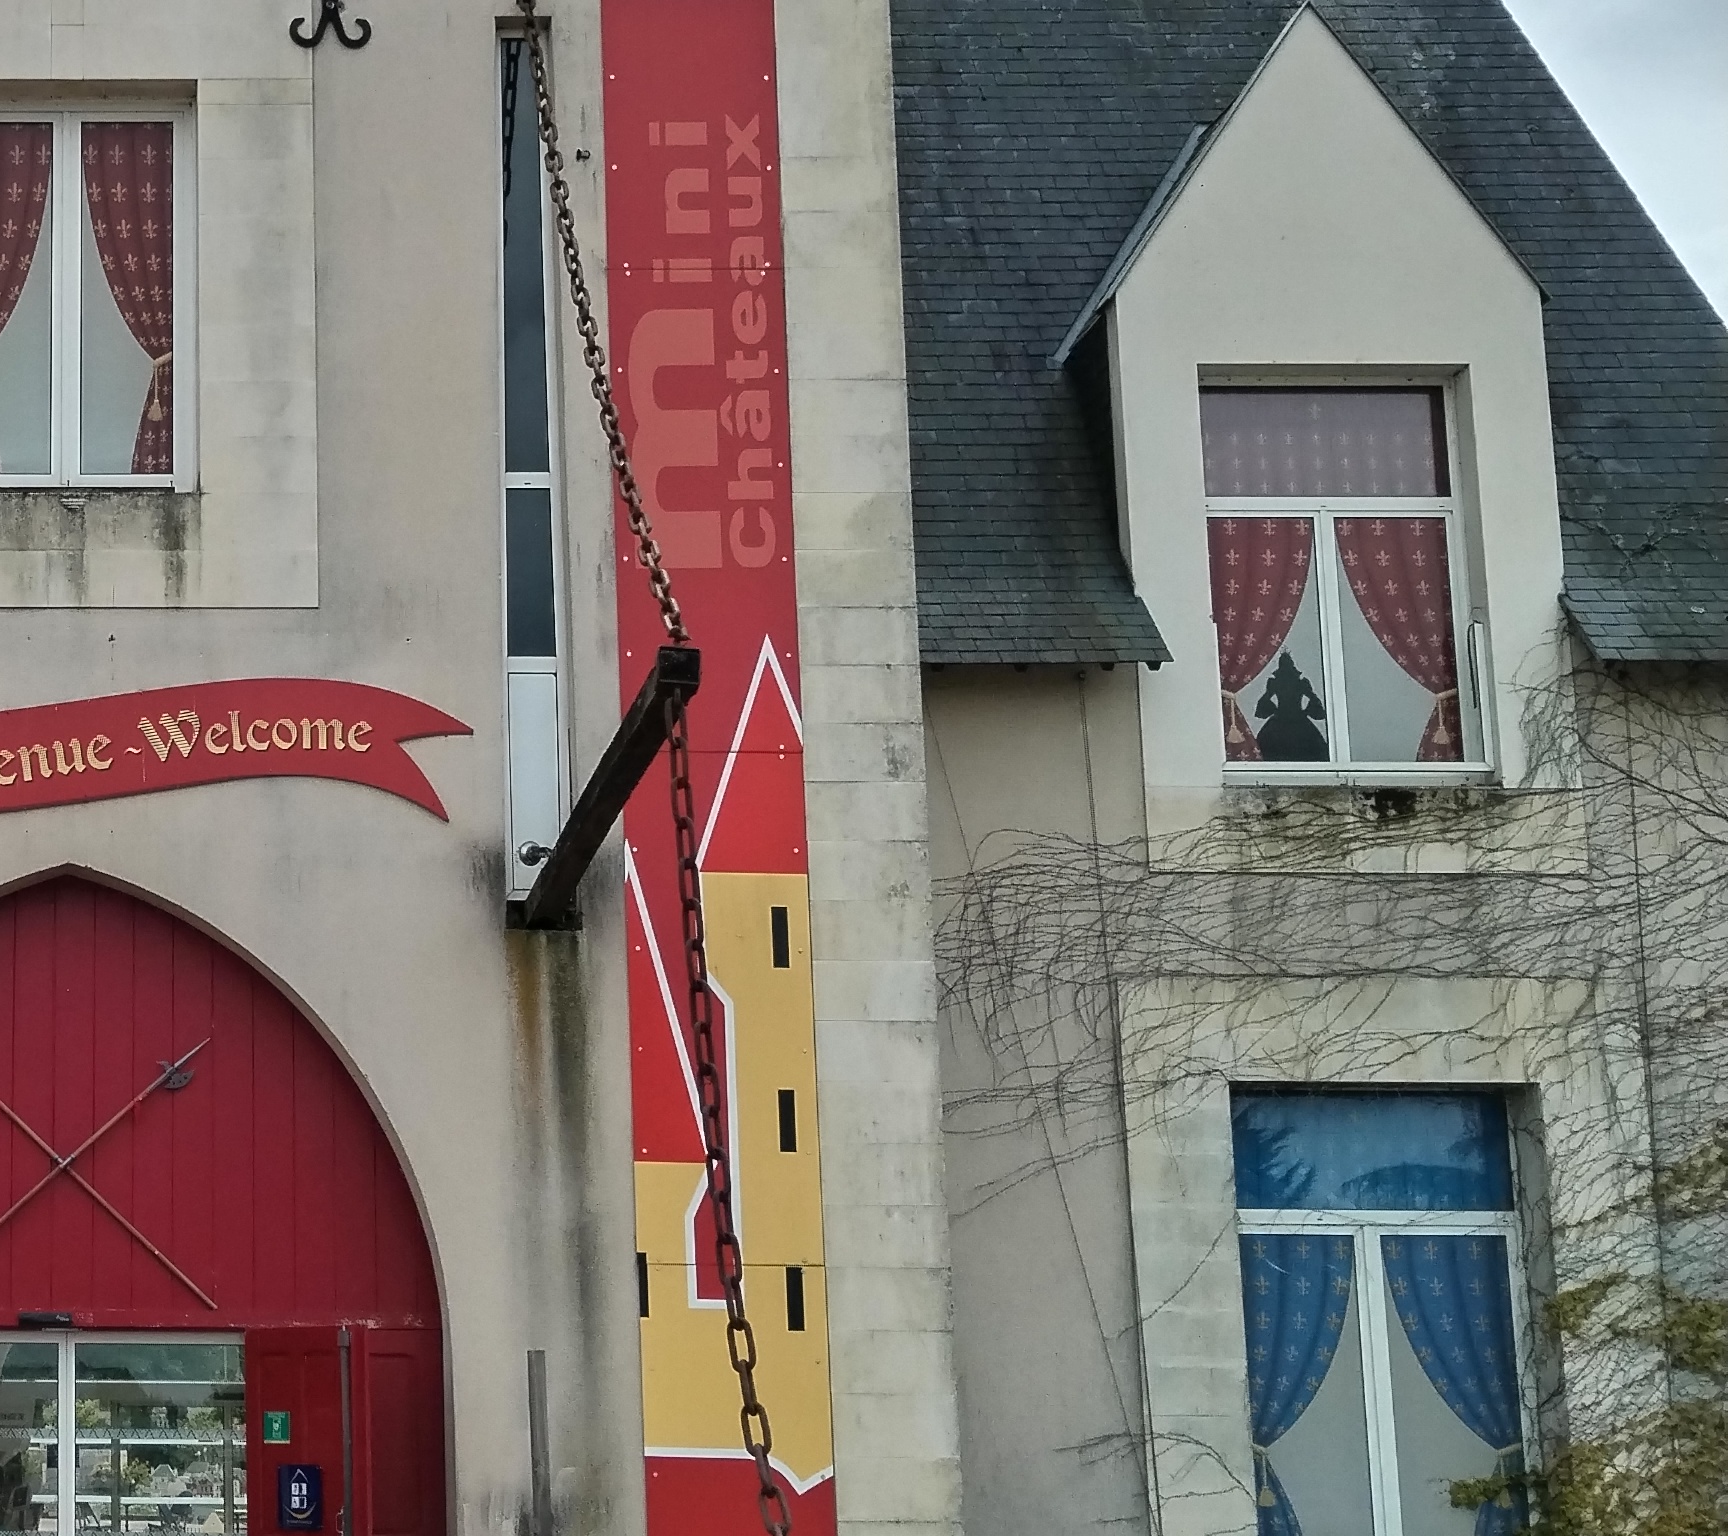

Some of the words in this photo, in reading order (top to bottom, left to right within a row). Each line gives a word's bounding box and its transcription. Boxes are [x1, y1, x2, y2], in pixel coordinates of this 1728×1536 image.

[628, 120, 722, 568] mini
[719, 113, 776, 568] Châteaux
[137, 709, 373, 762] Welcome
